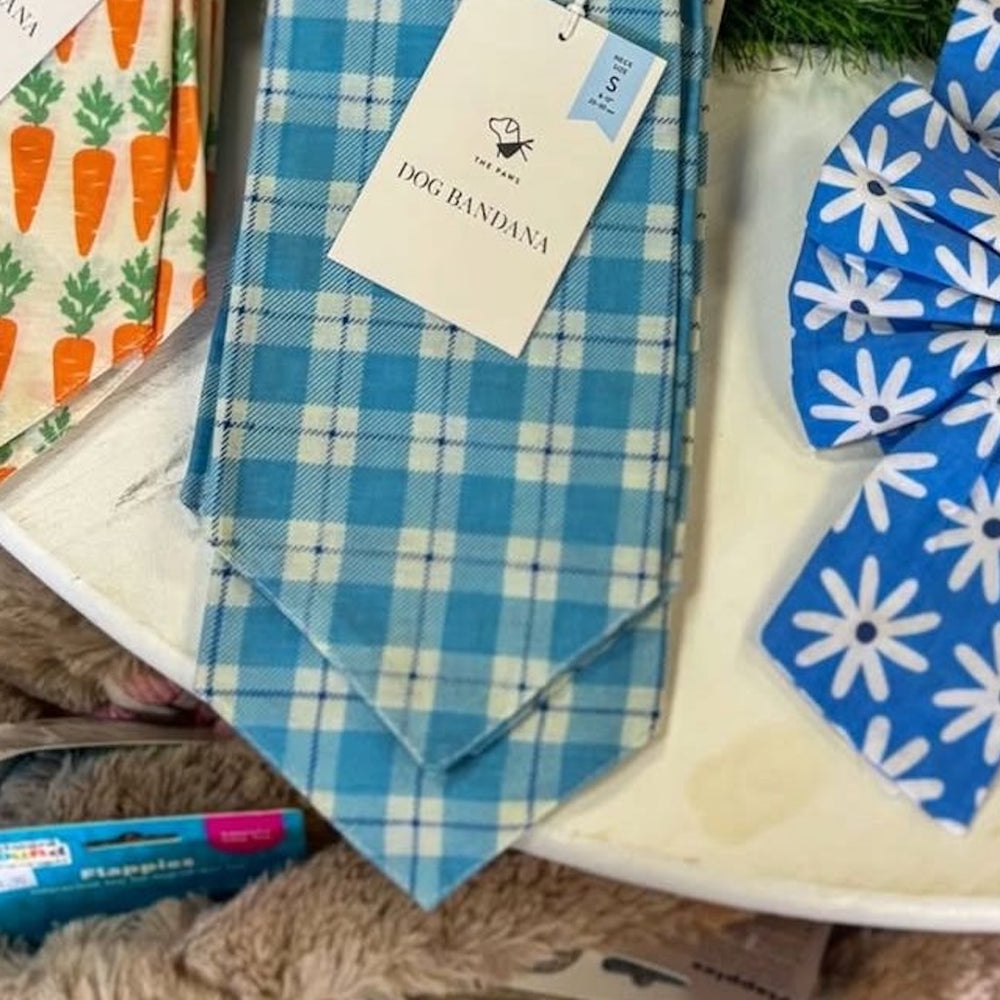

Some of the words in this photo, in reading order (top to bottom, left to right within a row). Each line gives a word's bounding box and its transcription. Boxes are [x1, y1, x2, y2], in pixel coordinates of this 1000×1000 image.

[612, 63, 628, 75] SIZE
[613, 54, 633, 69] NECK
[605, 76, 620, 92] S
[474, 155, 492, 170] THE
[495, 167, 520, 185] PAWS
[397, 161, 444, 196] DOG
[446, 187, 548, 254] BANDANA
